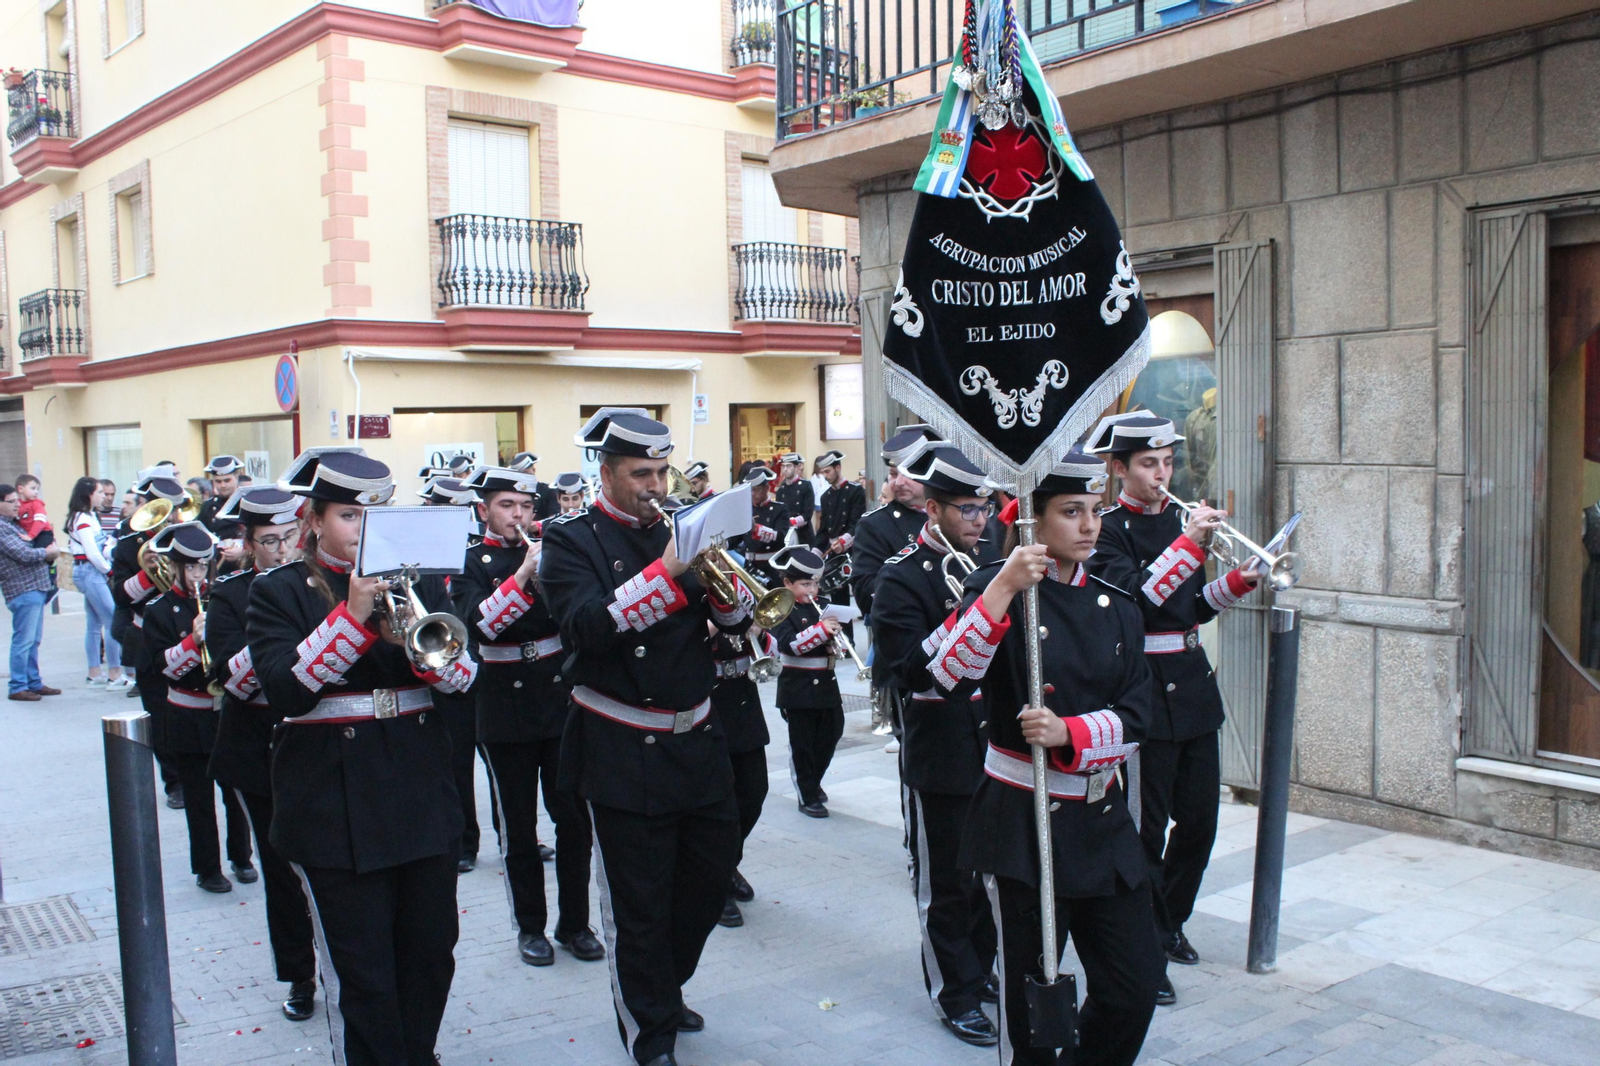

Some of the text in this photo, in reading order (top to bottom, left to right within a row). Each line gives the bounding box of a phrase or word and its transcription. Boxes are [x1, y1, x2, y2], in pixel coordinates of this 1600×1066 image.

[928, 225, 1087, 274] AGRUPACION MUSICAL
[931, 272, 1087, 307] CRISTO DEL AMOR
[966, 322, 1056, 343] EL EJIDO
